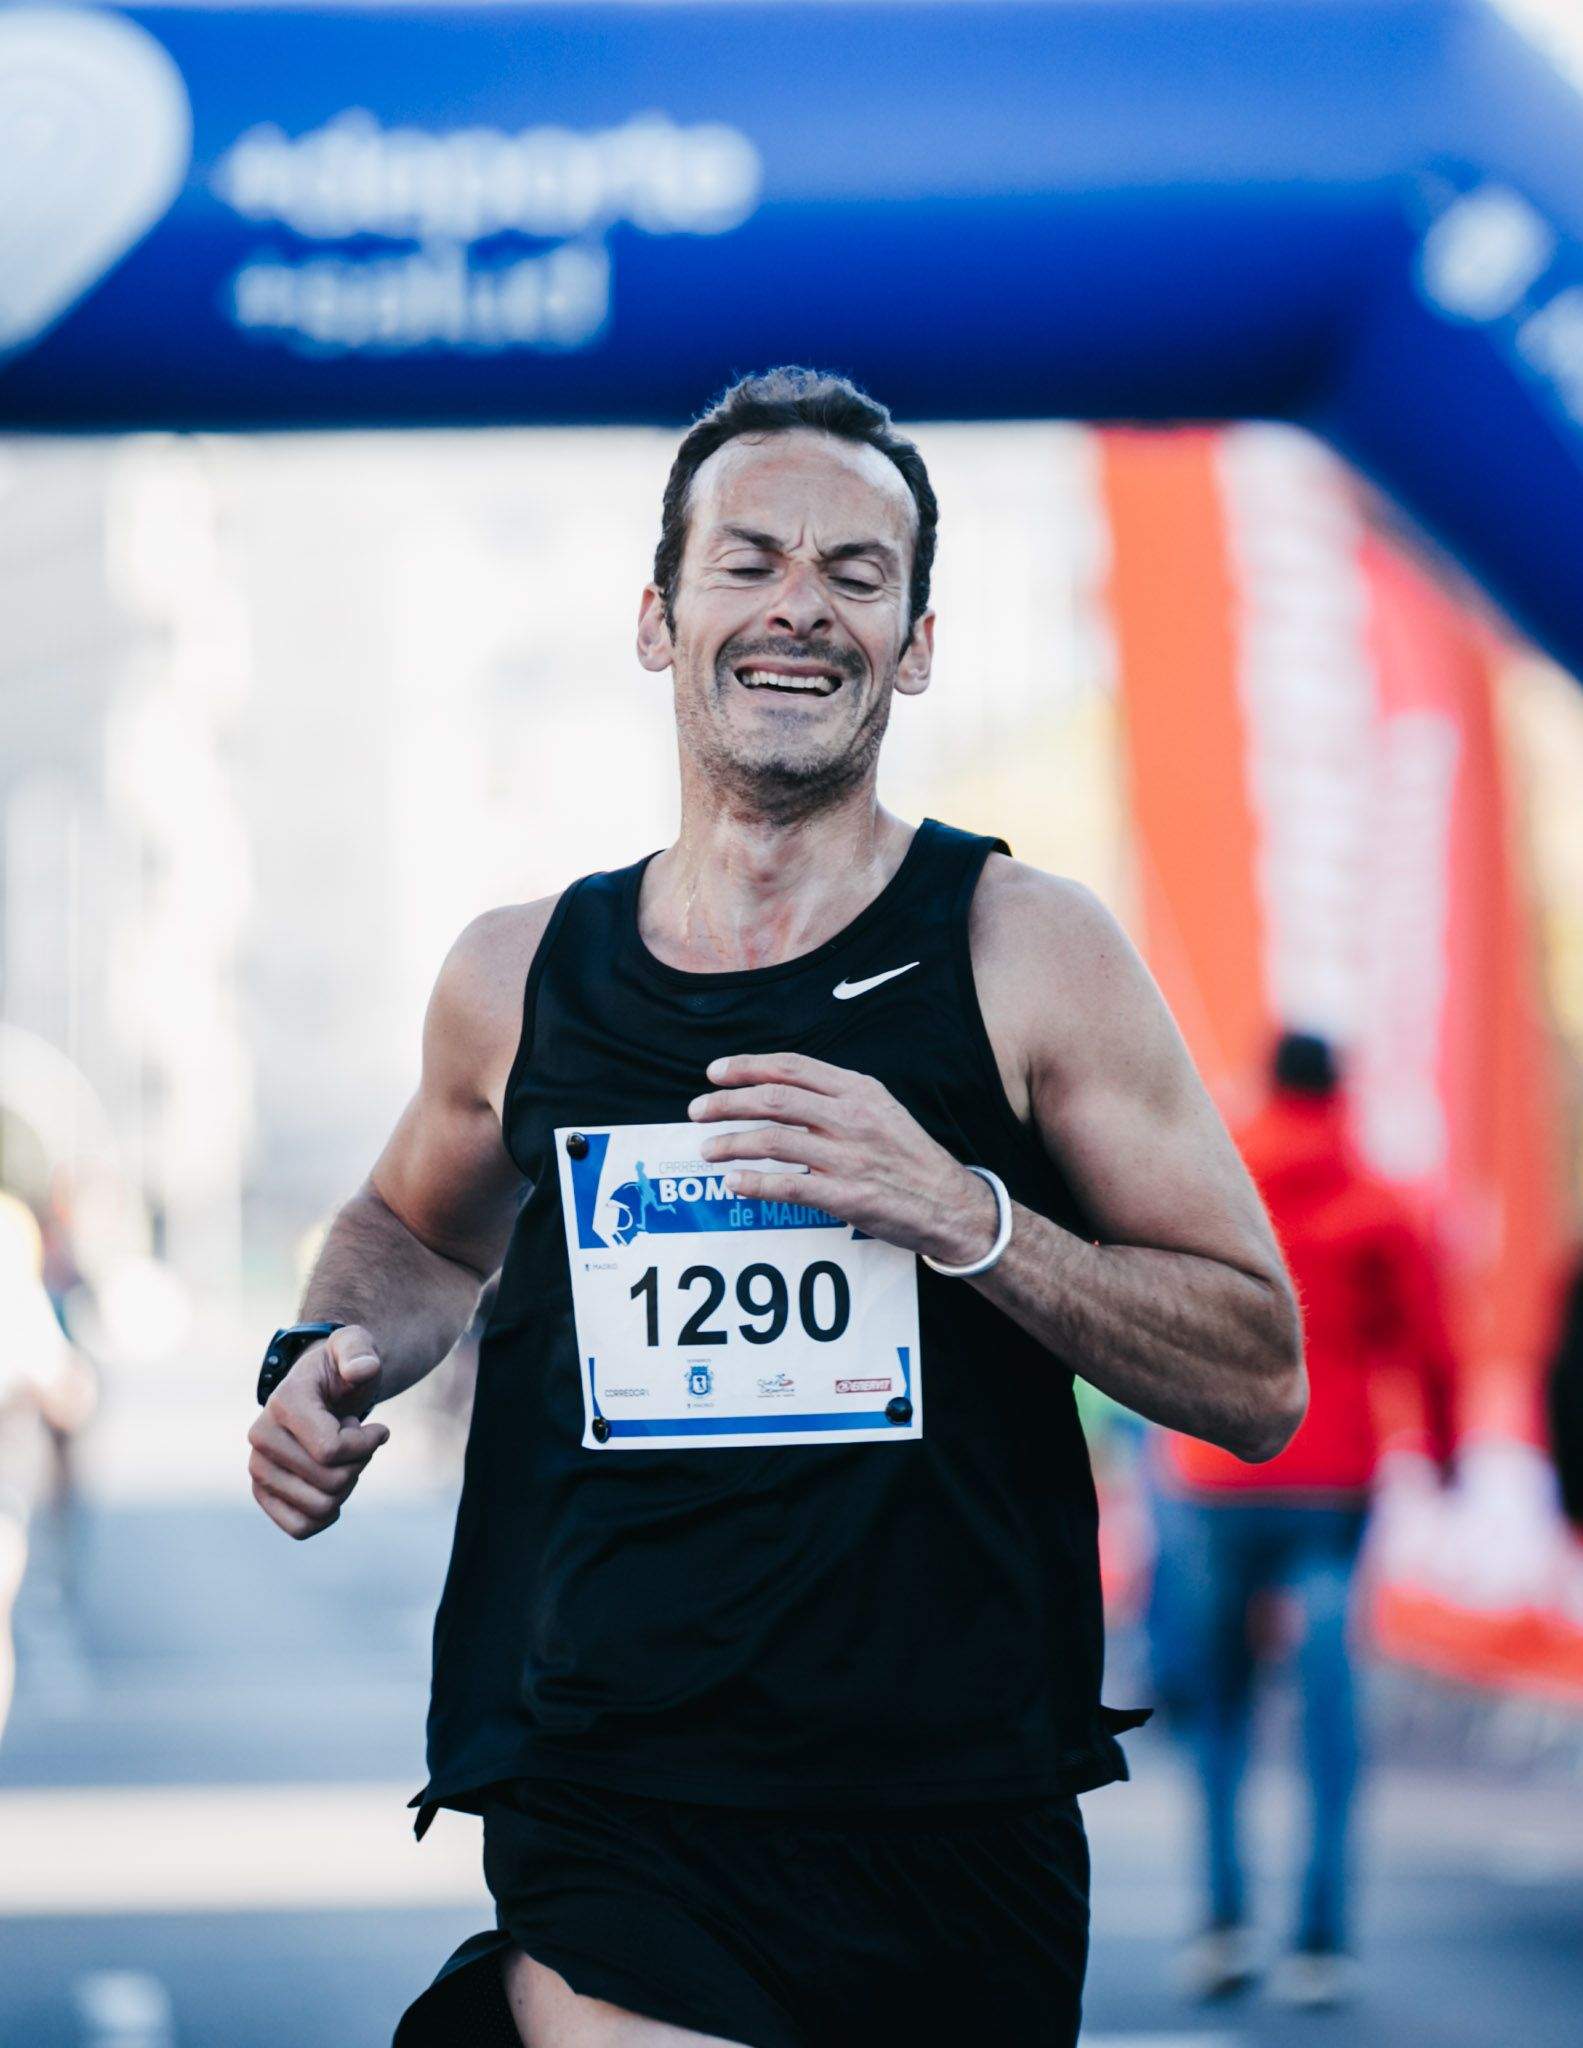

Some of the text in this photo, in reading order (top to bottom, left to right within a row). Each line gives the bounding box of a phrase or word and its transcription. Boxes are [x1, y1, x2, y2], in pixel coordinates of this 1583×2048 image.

[659, 1160, 713, 1174] CARRERA
[659, 1177, 747, 1203] BOM
[730, 1202, 753, 1227] de
[630, 1260, 850, 1347] 1290
